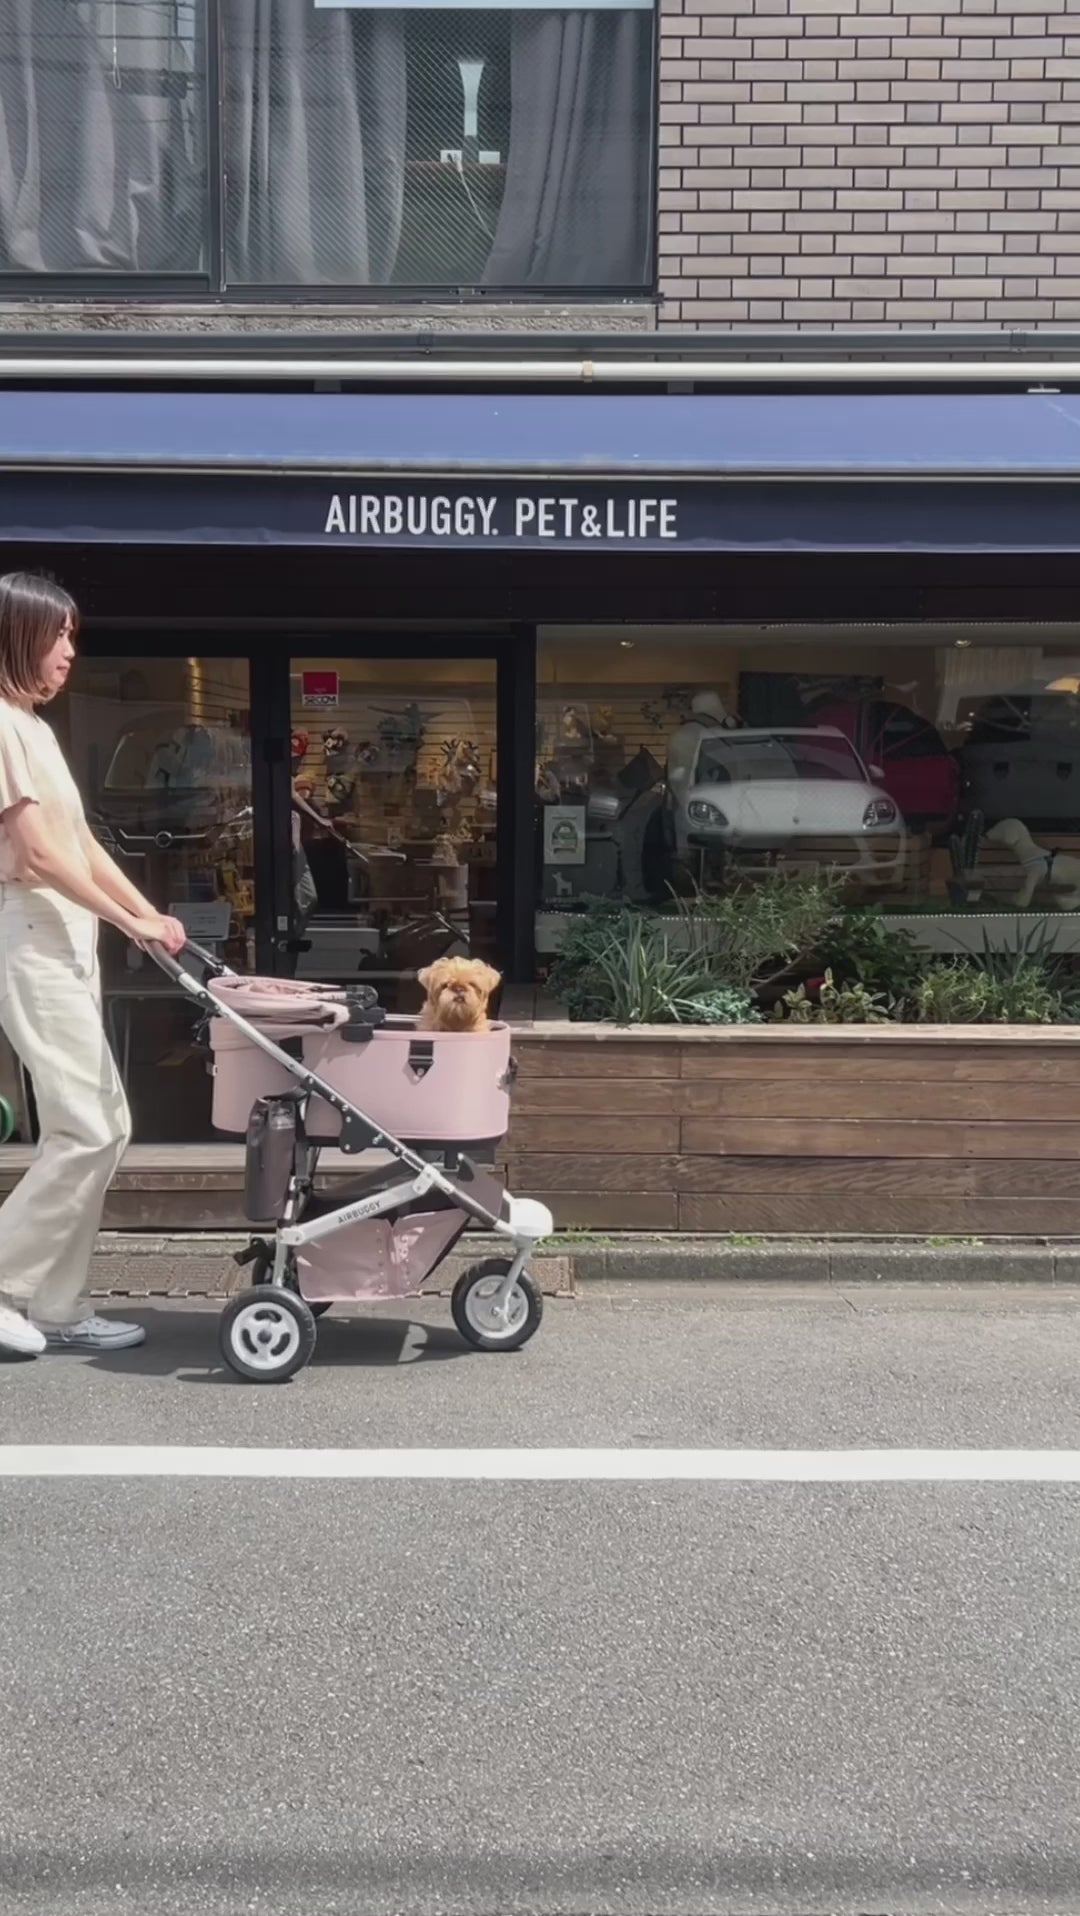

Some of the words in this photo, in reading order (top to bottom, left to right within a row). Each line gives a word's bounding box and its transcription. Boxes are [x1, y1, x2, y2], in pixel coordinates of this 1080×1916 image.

[325, 495, 498, 535] AIRBUGGY.
[515, 498, 677, 537] PET&LIFE
[338, 1200, 380, 1224] AIRBUGGY
